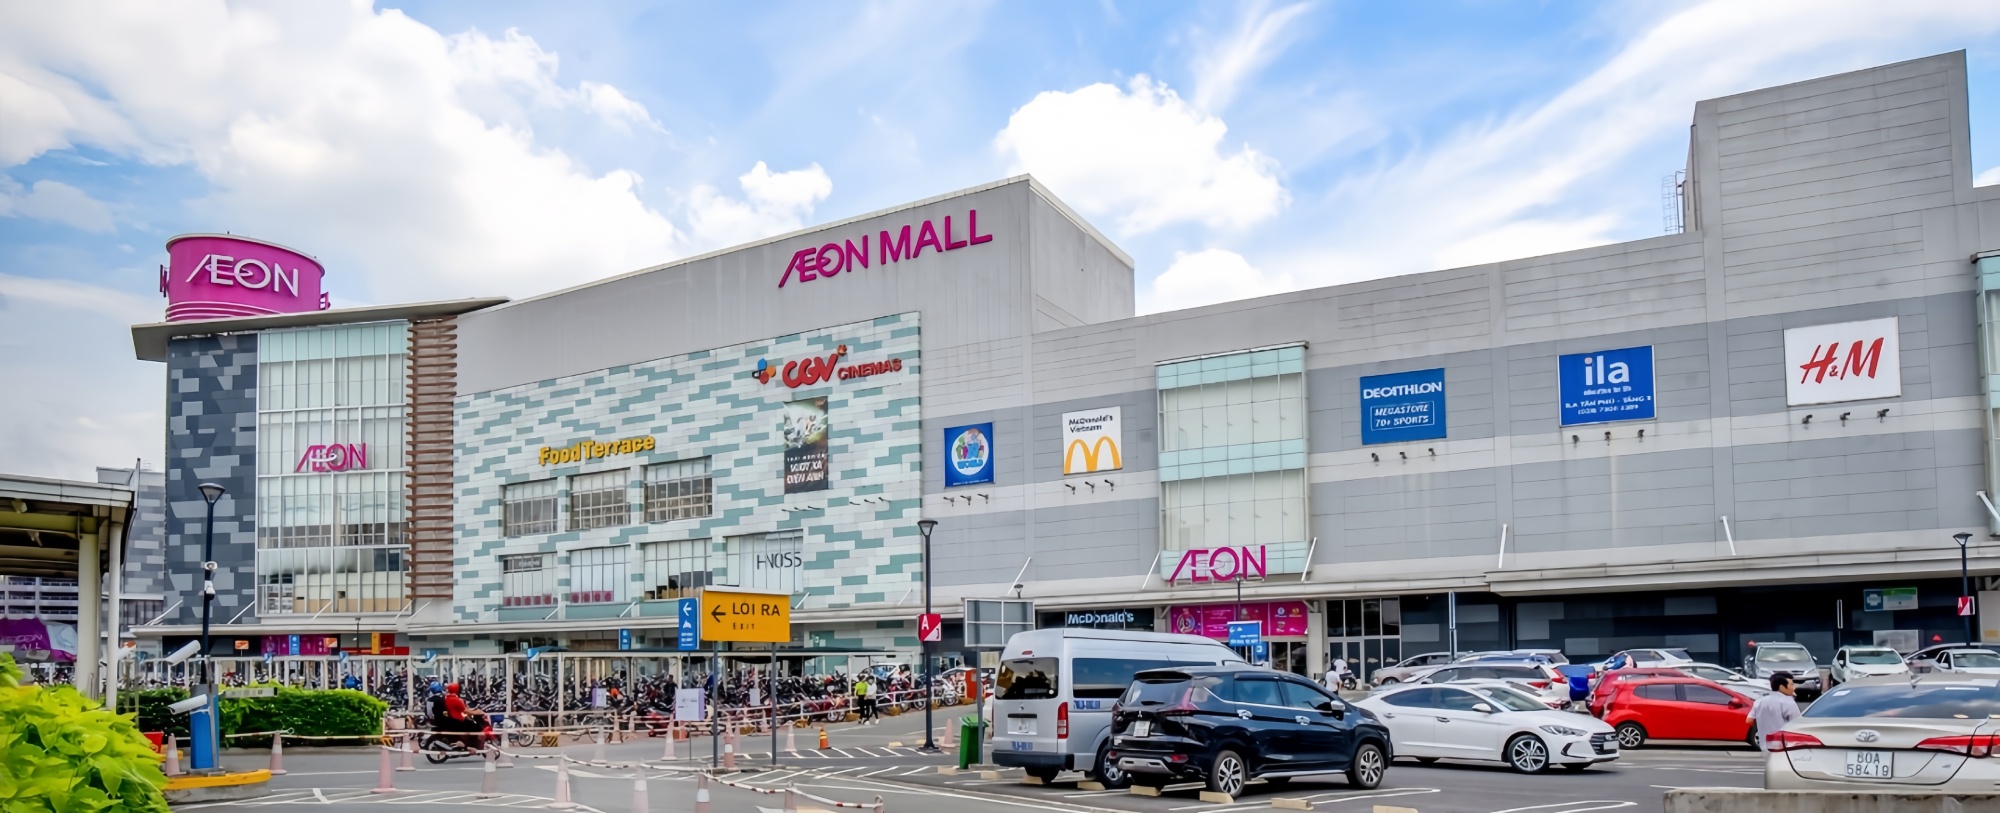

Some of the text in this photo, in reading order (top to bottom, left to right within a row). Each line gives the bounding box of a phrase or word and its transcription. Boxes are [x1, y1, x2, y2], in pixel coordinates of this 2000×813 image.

[880, 209, 993, 265] MALL
[1800, 337, 1884, 384] H&M
[782, 353, 902, 388] CGV CINEMAS
[1584, 355, 1630, 386] ila
[1363, 381, 1442, 399] DECATHLON
[1374, 404, 1430, 416] MEGASTORE
[1394, 415, 1429, 426] SPORTS
[761, 603, 781, 616] RA
[921, 615, 930, 630] A
[1068, 612, 1134, 624] McDonald's
